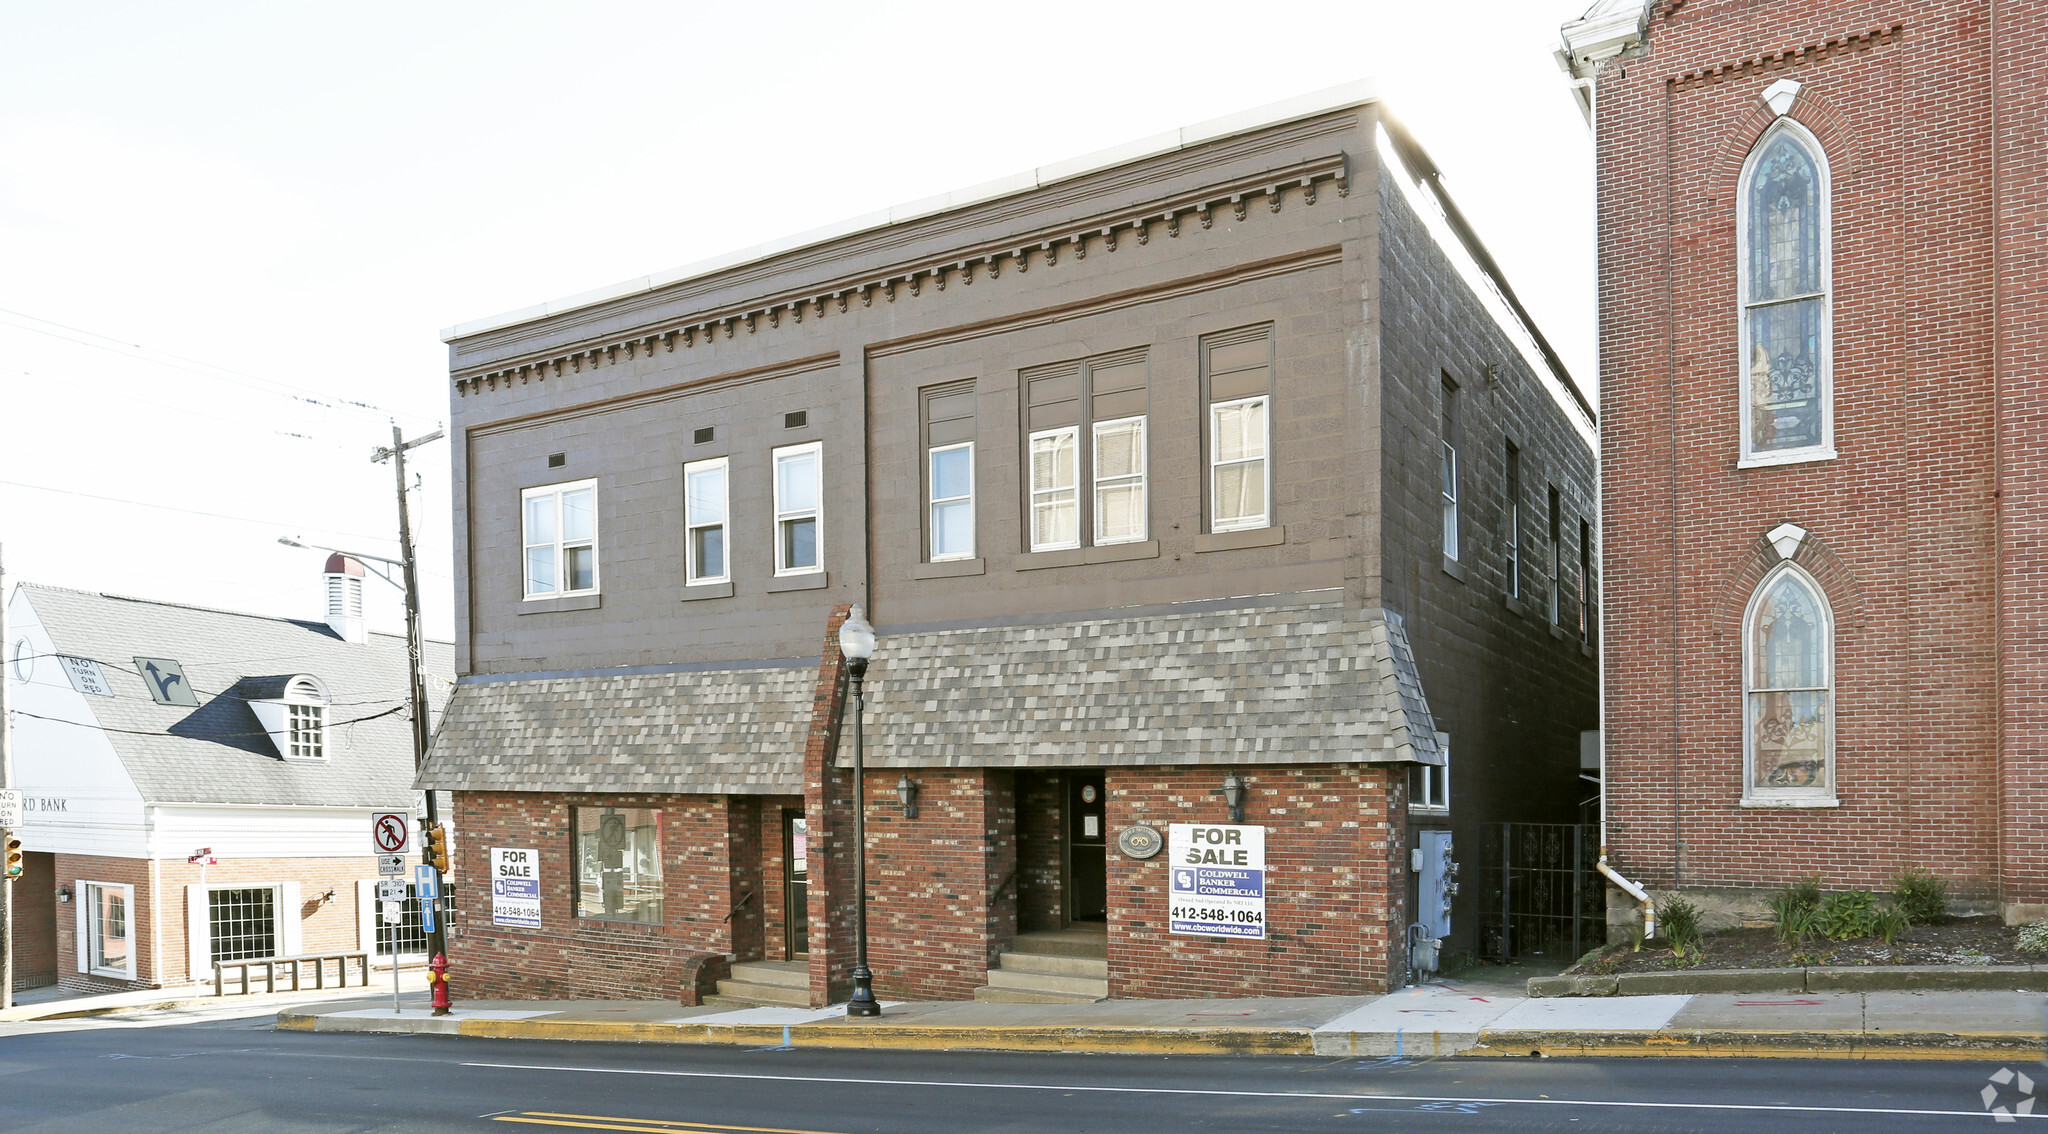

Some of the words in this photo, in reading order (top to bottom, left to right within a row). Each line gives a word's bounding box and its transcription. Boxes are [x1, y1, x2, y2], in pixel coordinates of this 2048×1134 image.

[69, 658, 89, 668] NO
[71, 667, 96, 676] TURN
[81, 676, 96, 684] ON
[83, 684, 102, 693] RED
[0, 791, 14, 800] NO
[23, 798, 36, 811] RD
[41, 798, 67, 812] BANK
[1192, 828, 1241, 845] FOR
[502, 851, 527, 863] FOR
[1185, 847, 1248, 866] SALE
[499, 864, 531, 877] SALE
[1199, 869, 1250, 879] COLDWELL
[418, 867, 435, 896] H
[1199, 878, 1236, 887] BANKER
[1199, 886, 1261, 897] COMMERCIAL
[494, 906, 540, 918] 412-548-1064
[1171, 906, 1263, 924] 412-548-1064
[1174, 923, 1260, 935] www.cbcworldwide.com
